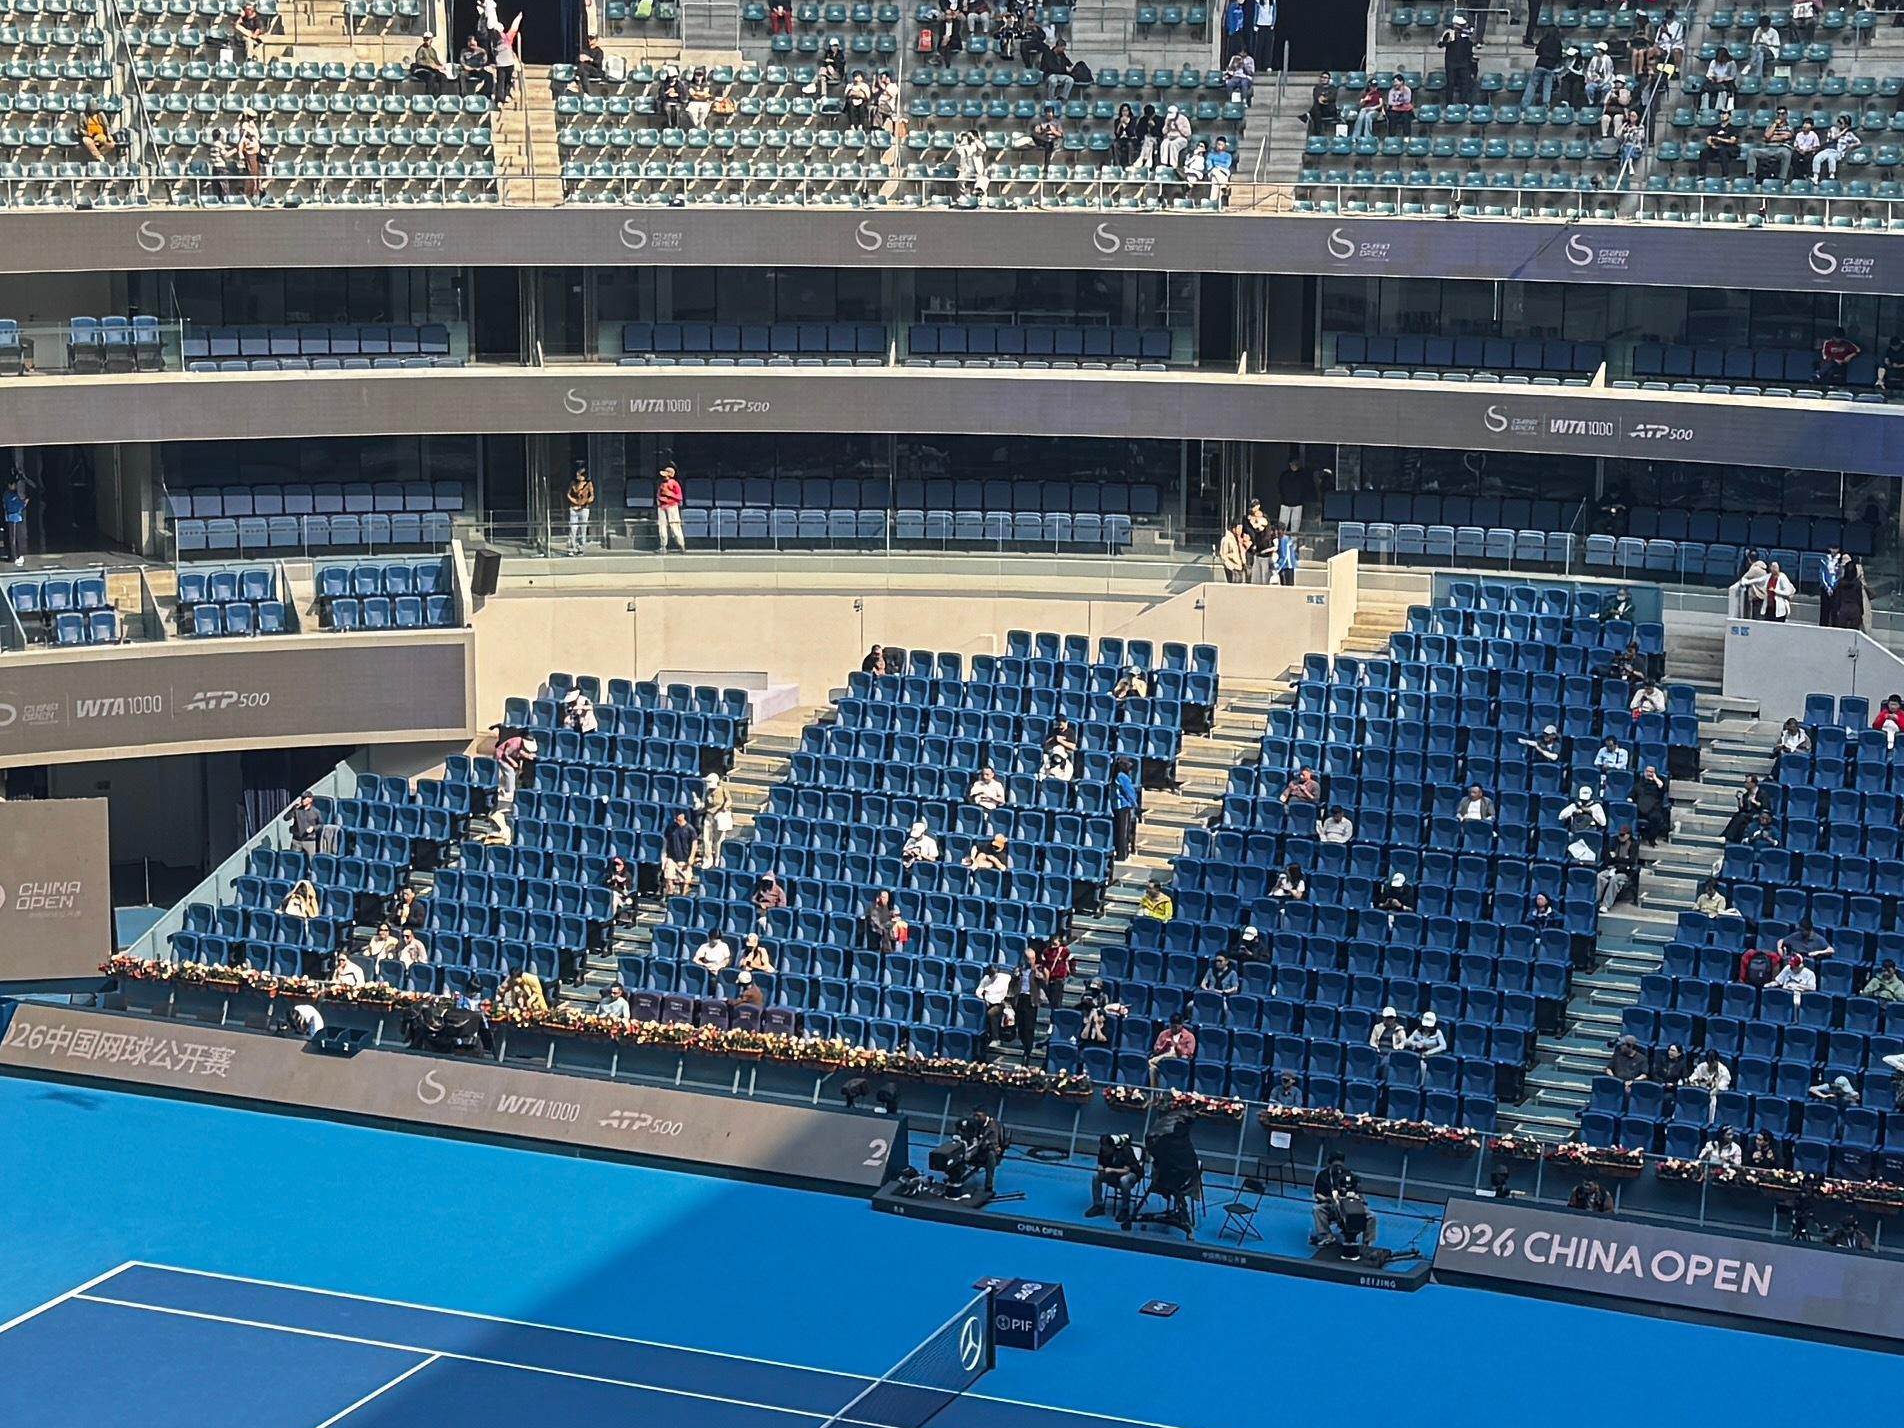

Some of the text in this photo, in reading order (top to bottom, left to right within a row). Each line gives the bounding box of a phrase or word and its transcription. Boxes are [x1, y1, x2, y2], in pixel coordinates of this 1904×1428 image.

[630, 399, 771, 413] WTA 1000 ATP 500
[1551, 419, 1694, 441] WTA 1000 ATP 500
[76, 690, 271, 719] WTA 1000 ATP 500
[19, 881, 81, 897] CHINA
[16, 894, 75, 910] OPEN
[497, 1094, 684, 1137] WTA 1000 ATP 500
[862, 1139, 888, 1167] 2
[1523, 1231, 1644, 1278] CHINA
[1650, 1250, 1774, 1297] OPEN
[1011, 1317, 1033, 1332] PIF
